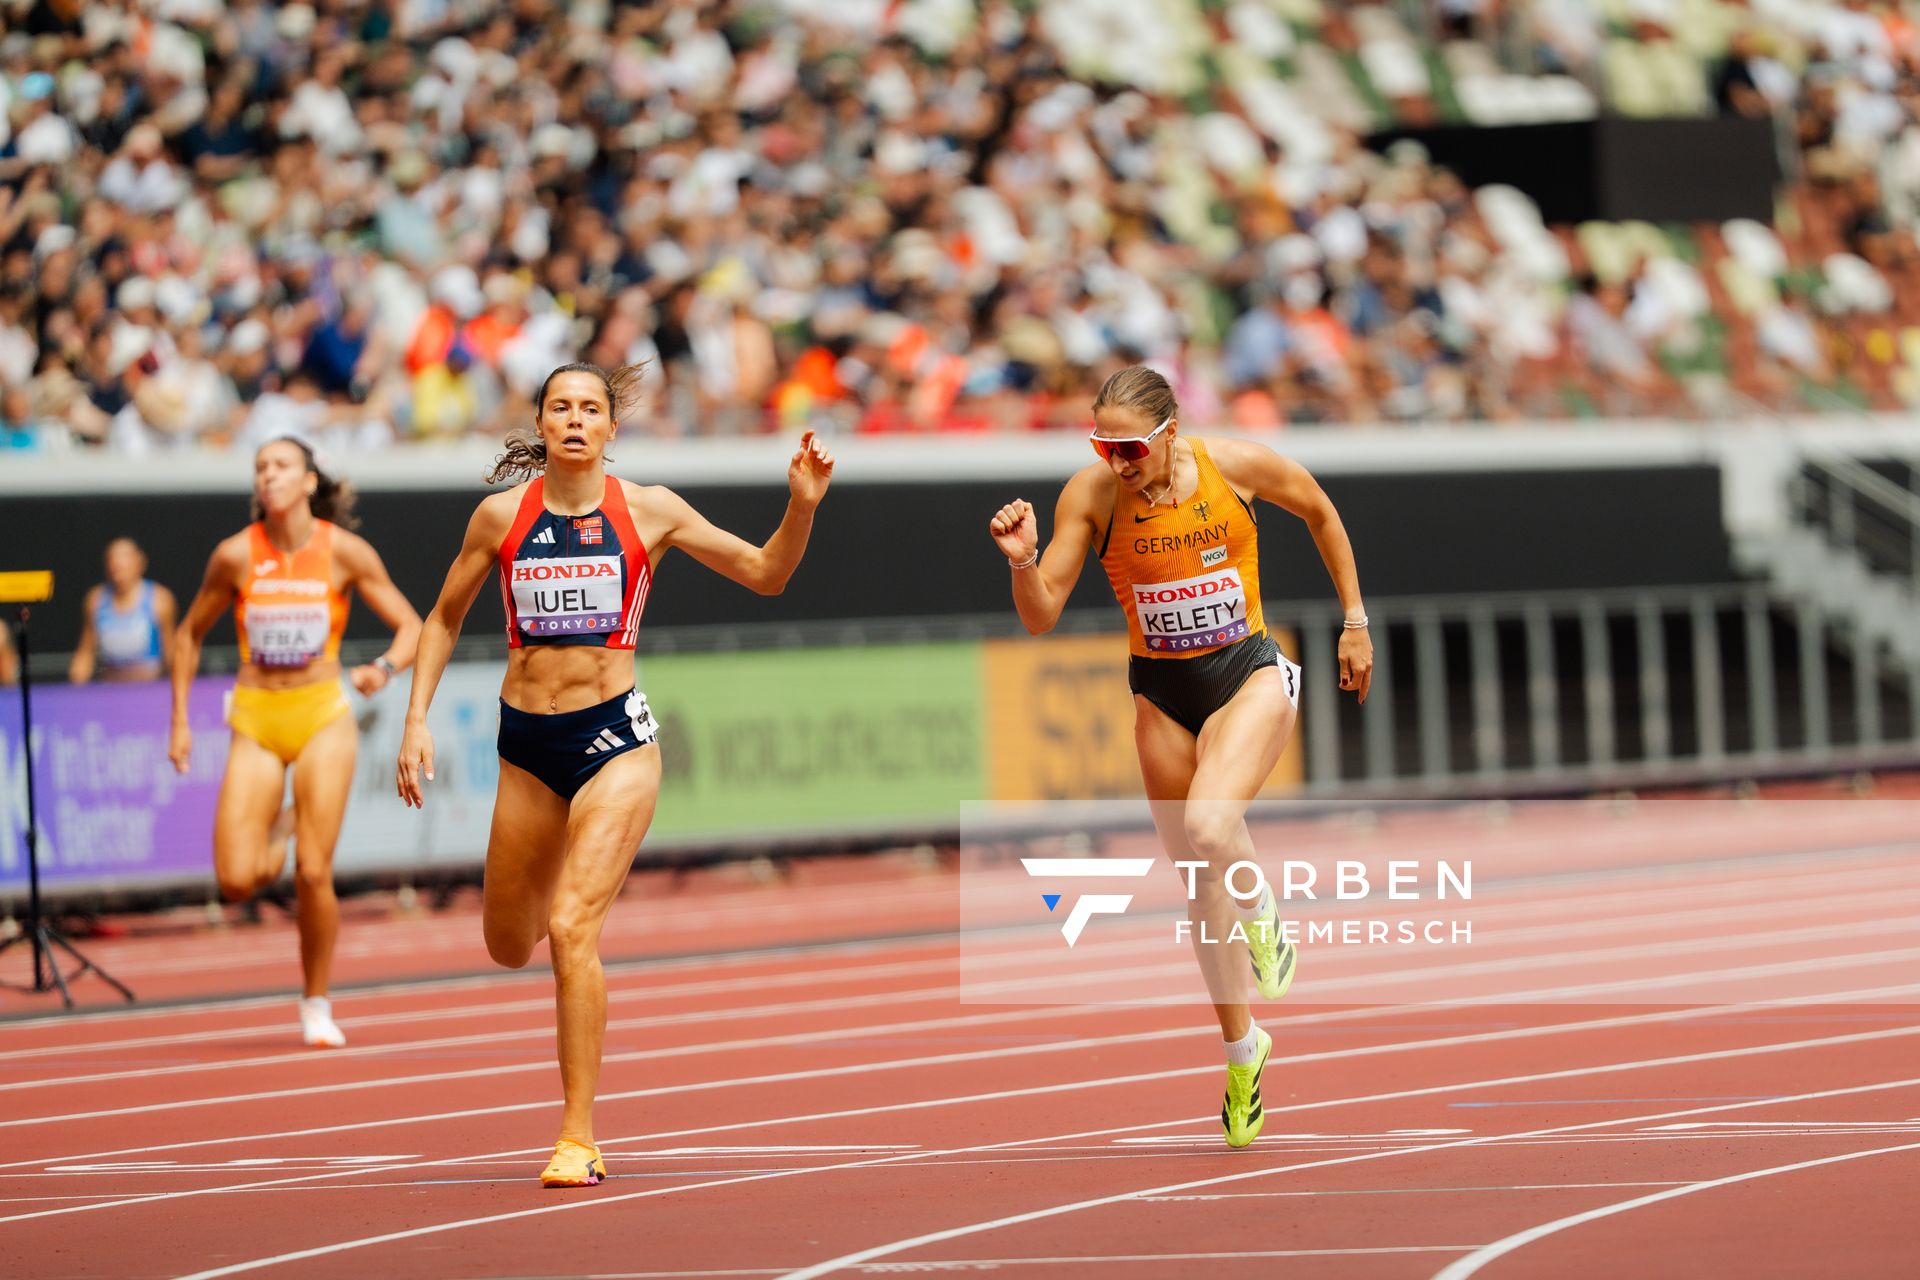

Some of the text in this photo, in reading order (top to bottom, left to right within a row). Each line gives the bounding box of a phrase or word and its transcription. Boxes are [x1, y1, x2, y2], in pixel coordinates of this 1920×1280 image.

[1134, 521, 1229, 555] GERMANY
[1202, 548, 1227, 563] WGV
[513, 563, 618, 581] HONDA
[534, 588, 598, 613] IUEL
[1136, 576, 1240, 604] HONDA
[1144, 598, 1239, 633] KELETY
[1285, 664, 1295, 698] 3
